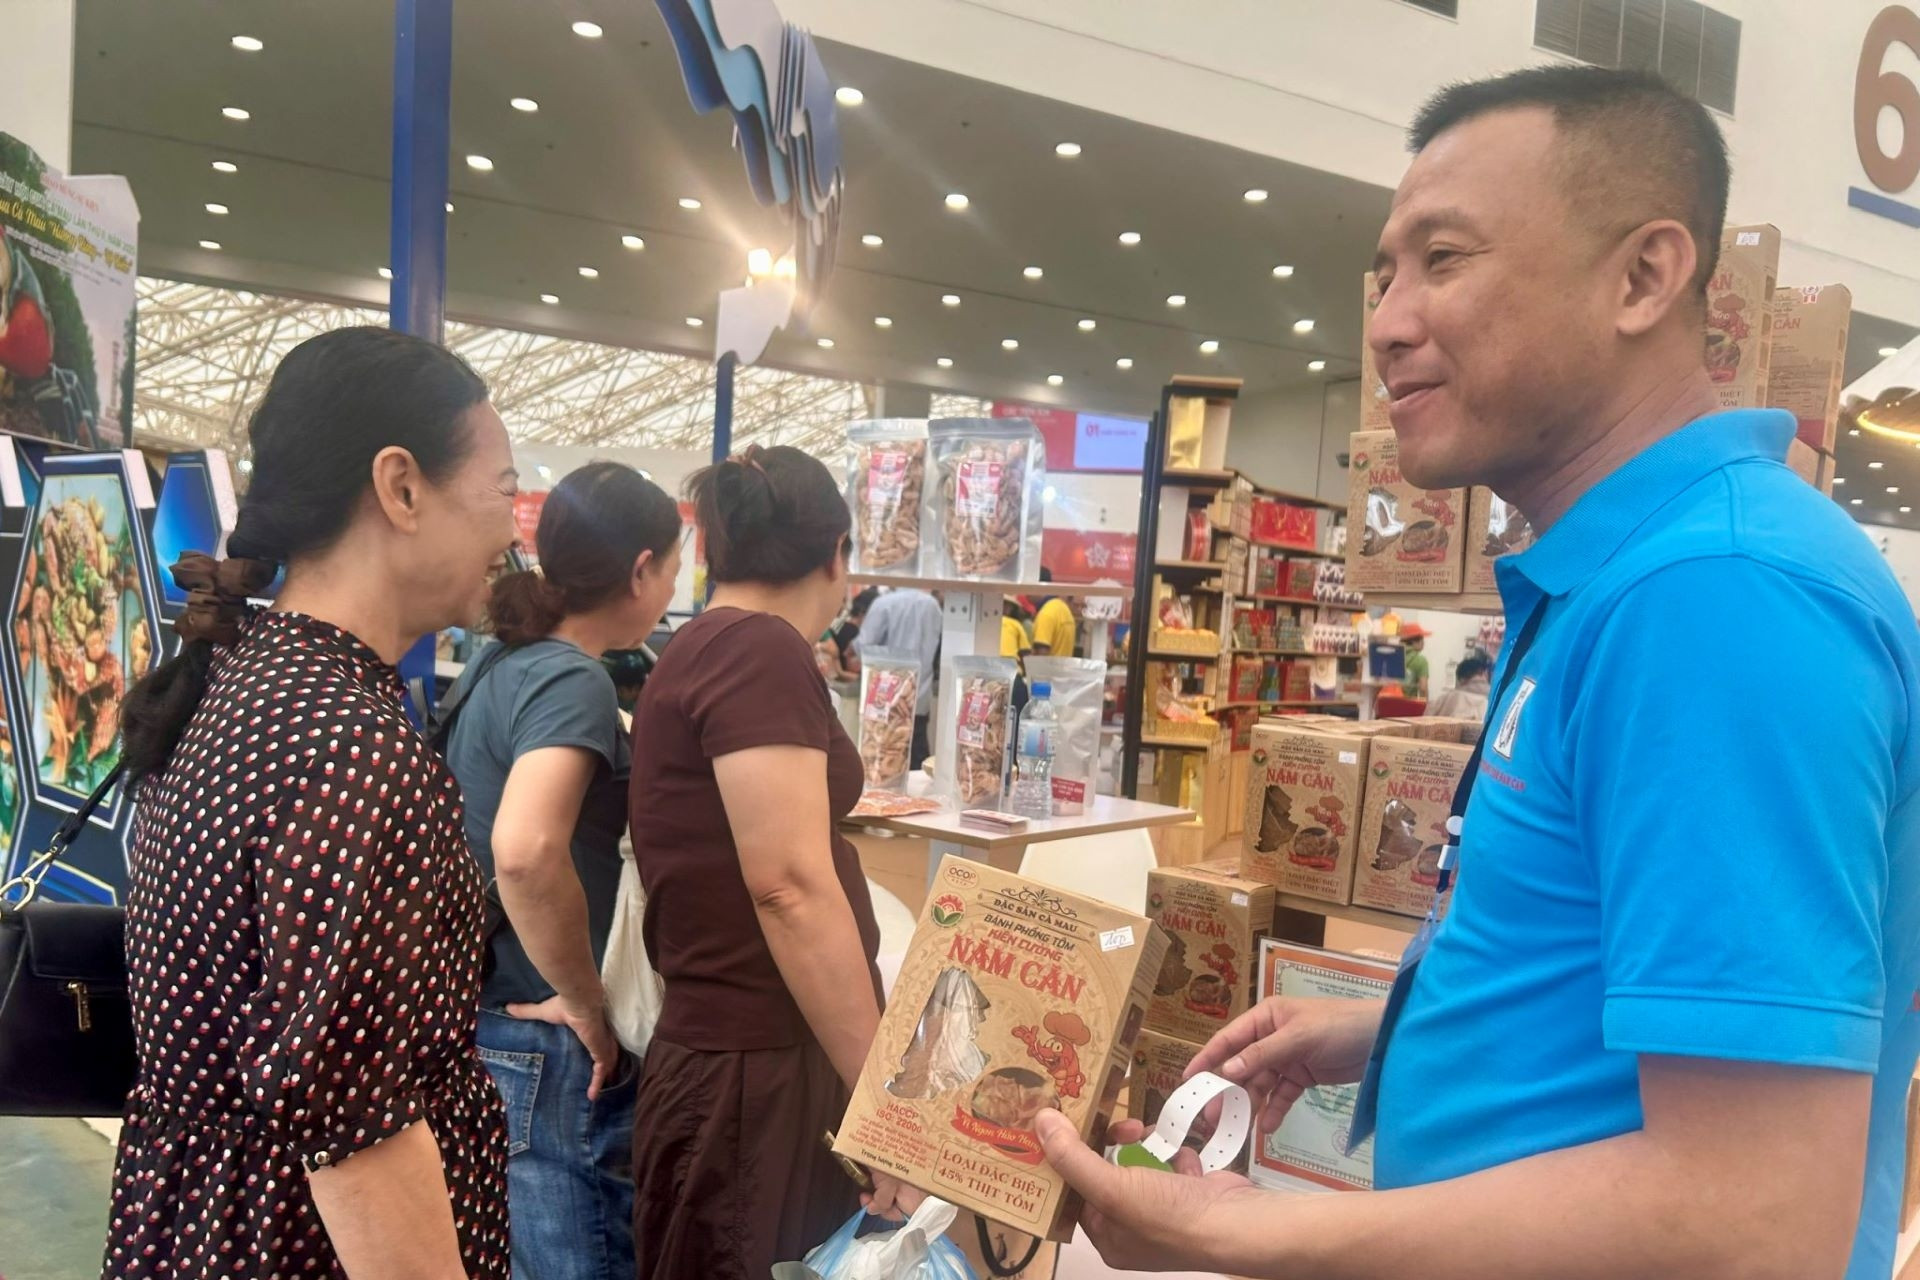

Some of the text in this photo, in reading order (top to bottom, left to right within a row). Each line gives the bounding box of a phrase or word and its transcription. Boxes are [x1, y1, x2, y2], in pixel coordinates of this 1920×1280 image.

[1853, 5, 1920, 194] 6
[983, 913, 1015, 931] BÁNH
[1051, 935, 1077, 952] TÔM
[1054, 919, 1079, 933] MAU
[946, 932, 1087, 1004] NĂM CĂN
[886, 1102, 919, 1119] HACCP
[896, 1117, 922, 1134] 22000
[938, 1167, 1035, 1214] 45% THỊT TÔM
[942, 1149, 1045, 1198] LOẠI ĐẶC BIỆT
